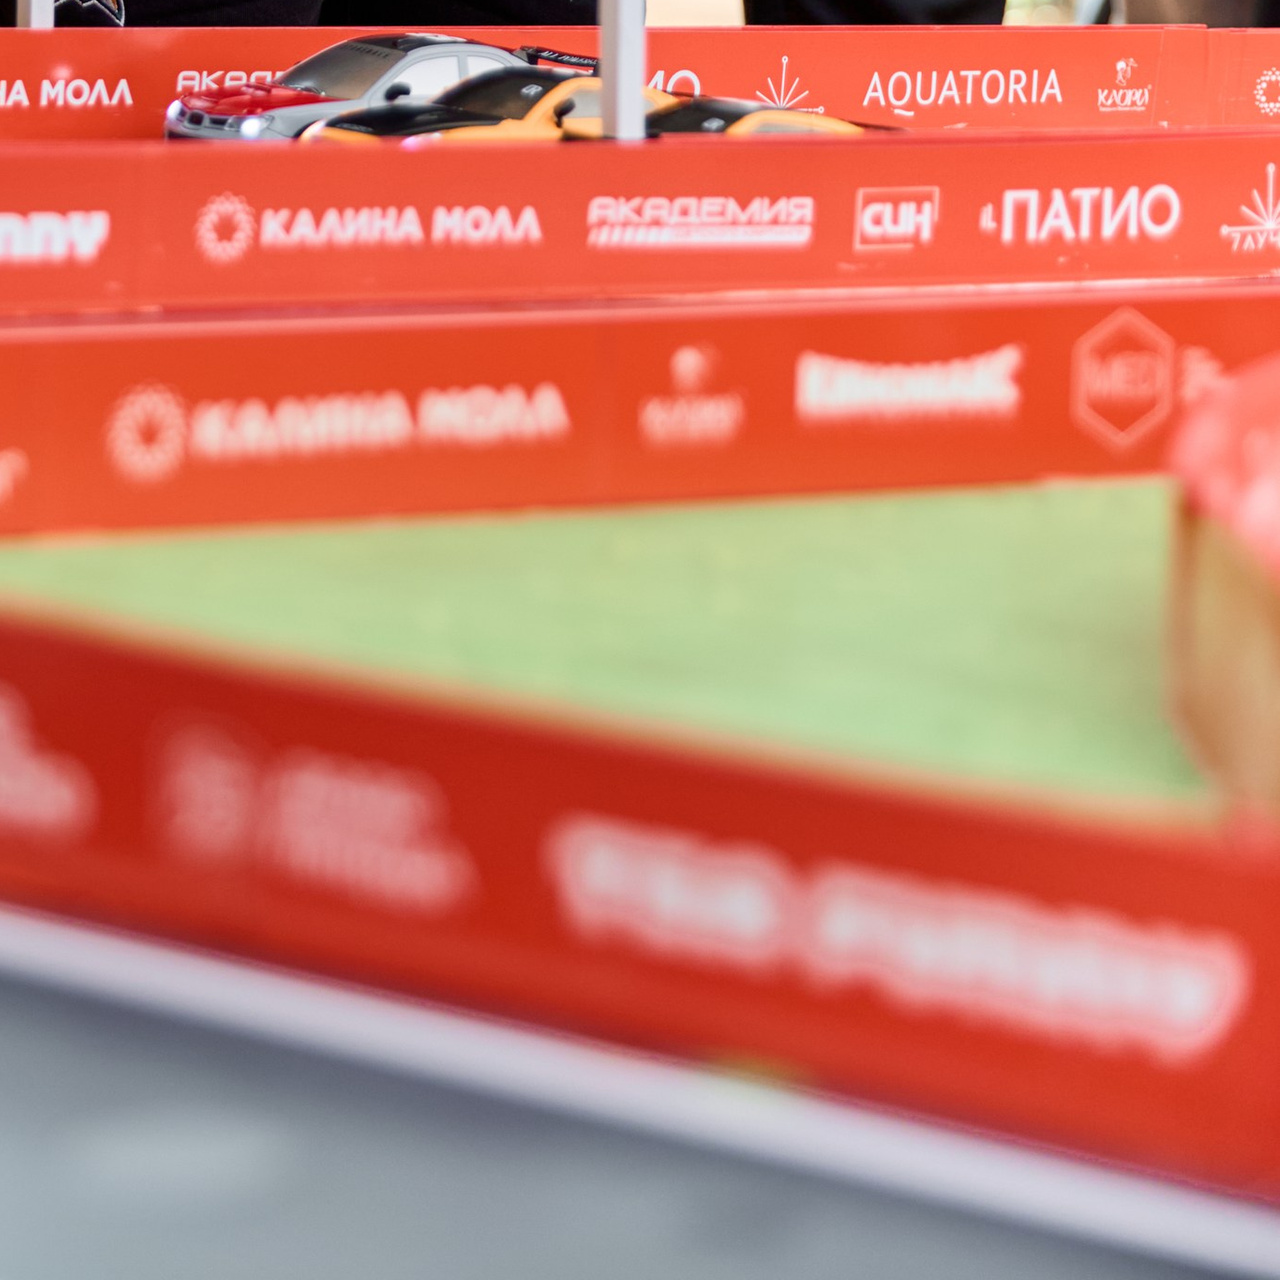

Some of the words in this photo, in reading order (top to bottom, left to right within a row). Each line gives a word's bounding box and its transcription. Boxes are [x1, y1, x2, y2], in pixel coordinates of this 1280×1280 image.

[39, 79, 133, 108] МОЛЛ
[863, 69, 1063, 117] AQUATORIA
[260, 206, 424, 247] КАЛИНА
[431, 205, 542, 244] МОЛЛ
[587, 195, 814, 225] АКАДЕМИЯ
[1001, 183, 1181, 244] ПАТИО
